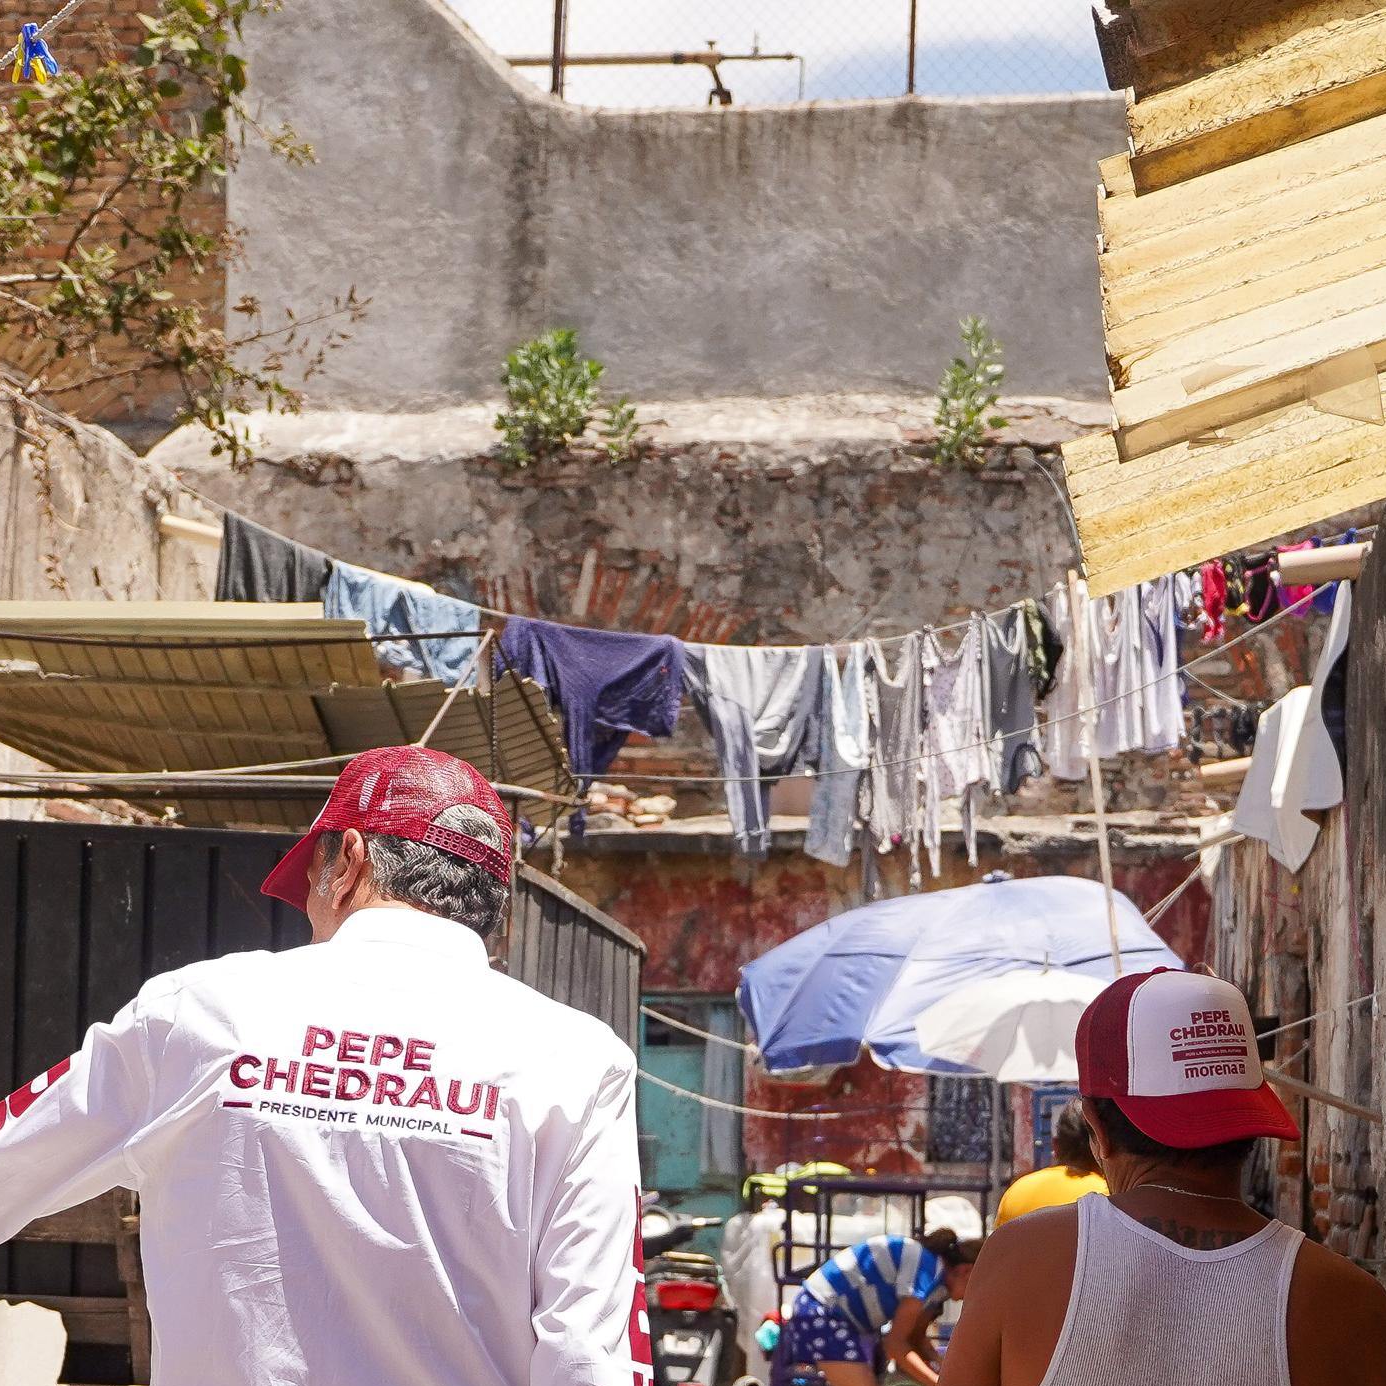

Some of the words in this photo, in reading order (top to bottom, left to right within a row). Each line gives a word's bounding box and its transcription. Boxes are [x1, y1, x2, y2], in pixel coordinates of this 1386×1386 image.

[1190, 1010, 1230, 1025] PEPE
[1170, 1024, 1245, 1041] CHEDRAUI
[301, 1024, 437, 1071] PEPE
[1185, 1064, 1238, 1078] morena
[229, 1054, 501, 1120] CHEDRAUI
[258, 1100, 357, 1125] PRESIDENTE
[365, 1114, 452, 1136] MUNICIPAL
